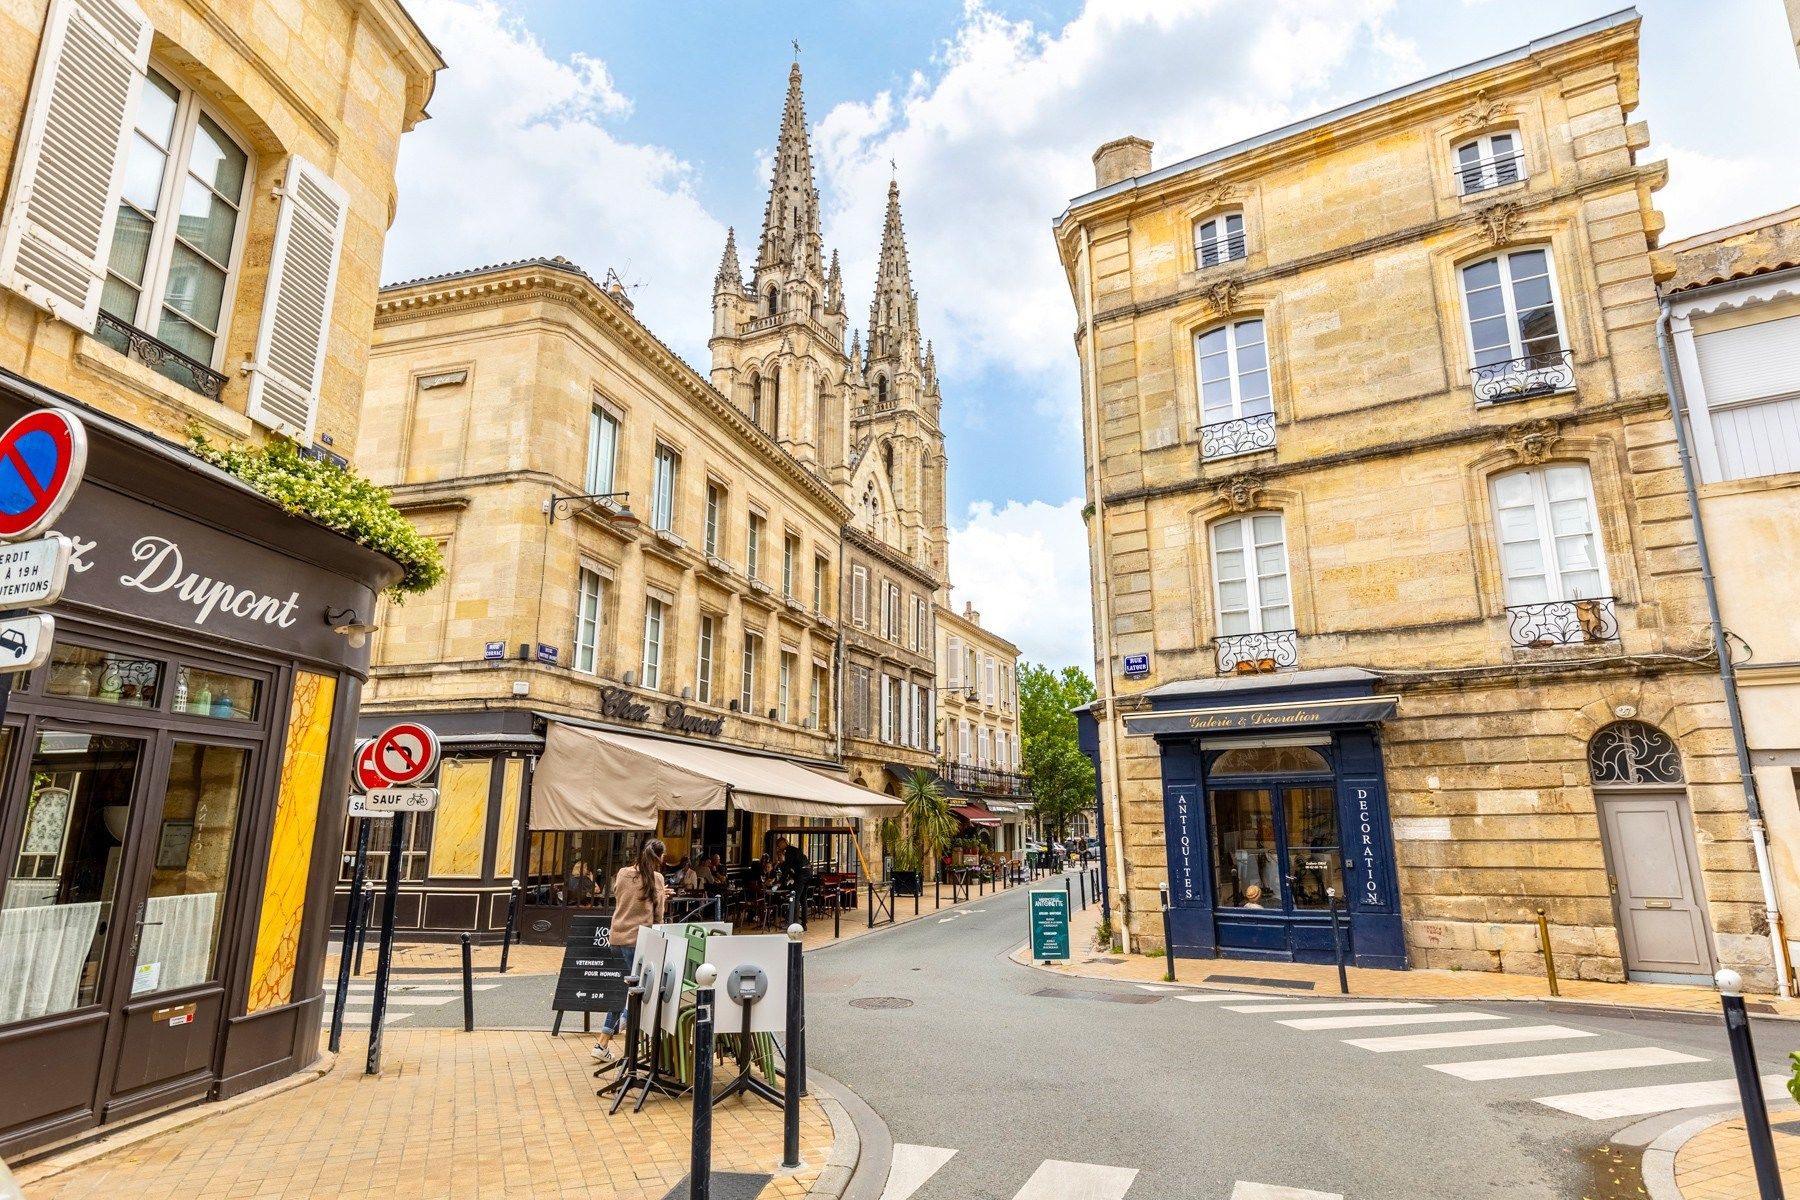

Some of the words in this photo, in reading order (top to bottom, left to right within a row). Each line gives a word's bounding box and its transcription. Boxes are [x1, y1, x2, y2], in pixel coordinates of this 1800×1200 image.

[119, 535, 300, 628] Dupont
[662, 700, 726, 737] Dupont
[1189, 714, 1233, 729] Galerie
[1237, 717, 1247, 727] &
[1250, 710, 1321, 726] Décoration
[372, 795, 402, 805] SAUF
[1178, 794, 1193, 899] ANTIQUITES
[1357, 789, 1378, 904] DECORATION
